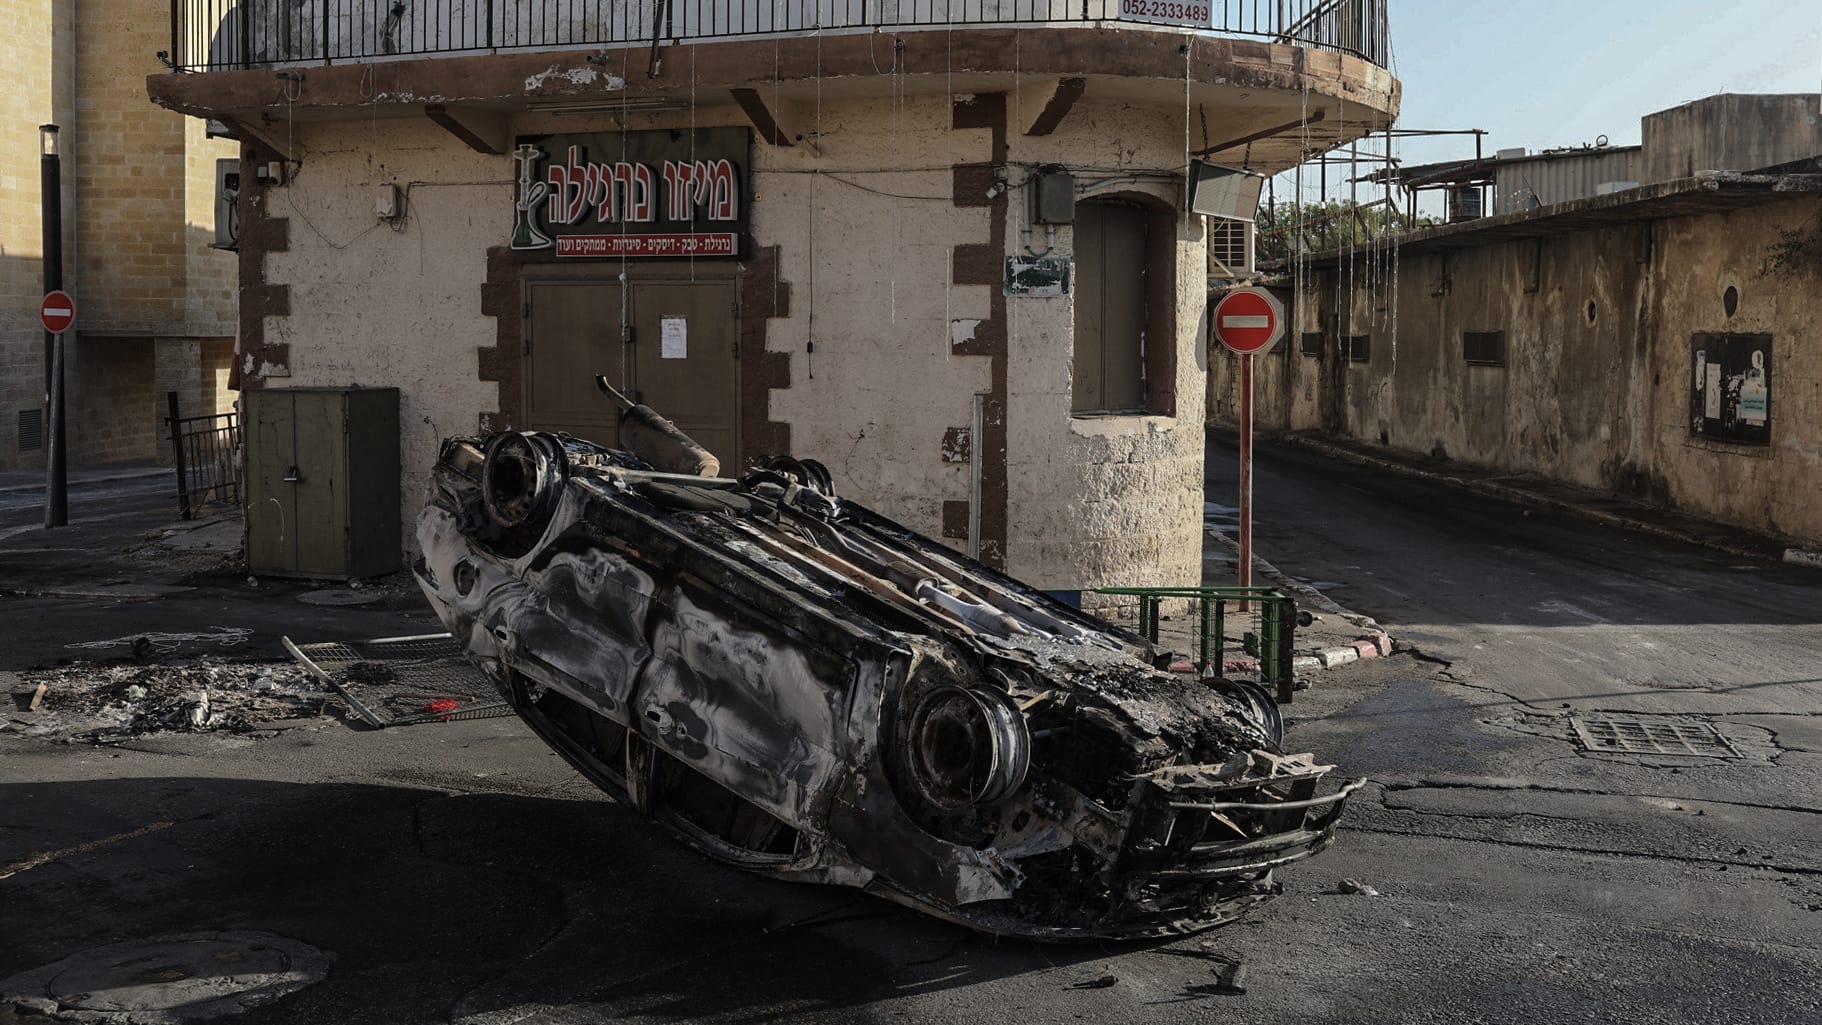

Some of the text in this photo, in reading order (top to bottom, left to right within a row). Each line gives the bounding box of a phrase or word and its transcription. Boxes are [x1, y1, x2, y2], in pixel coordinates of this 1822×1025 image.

[1123, 0, 1208, 21] 052-2333489
[549, 144, 737, 224] מיזו נרגילה
[558, 239, 574, 251] ועוד
[576, 239, 606, 254] ממתקים
[648, 238, 675, 254] דיסקים
[682, 238, 698, 254] טבק
